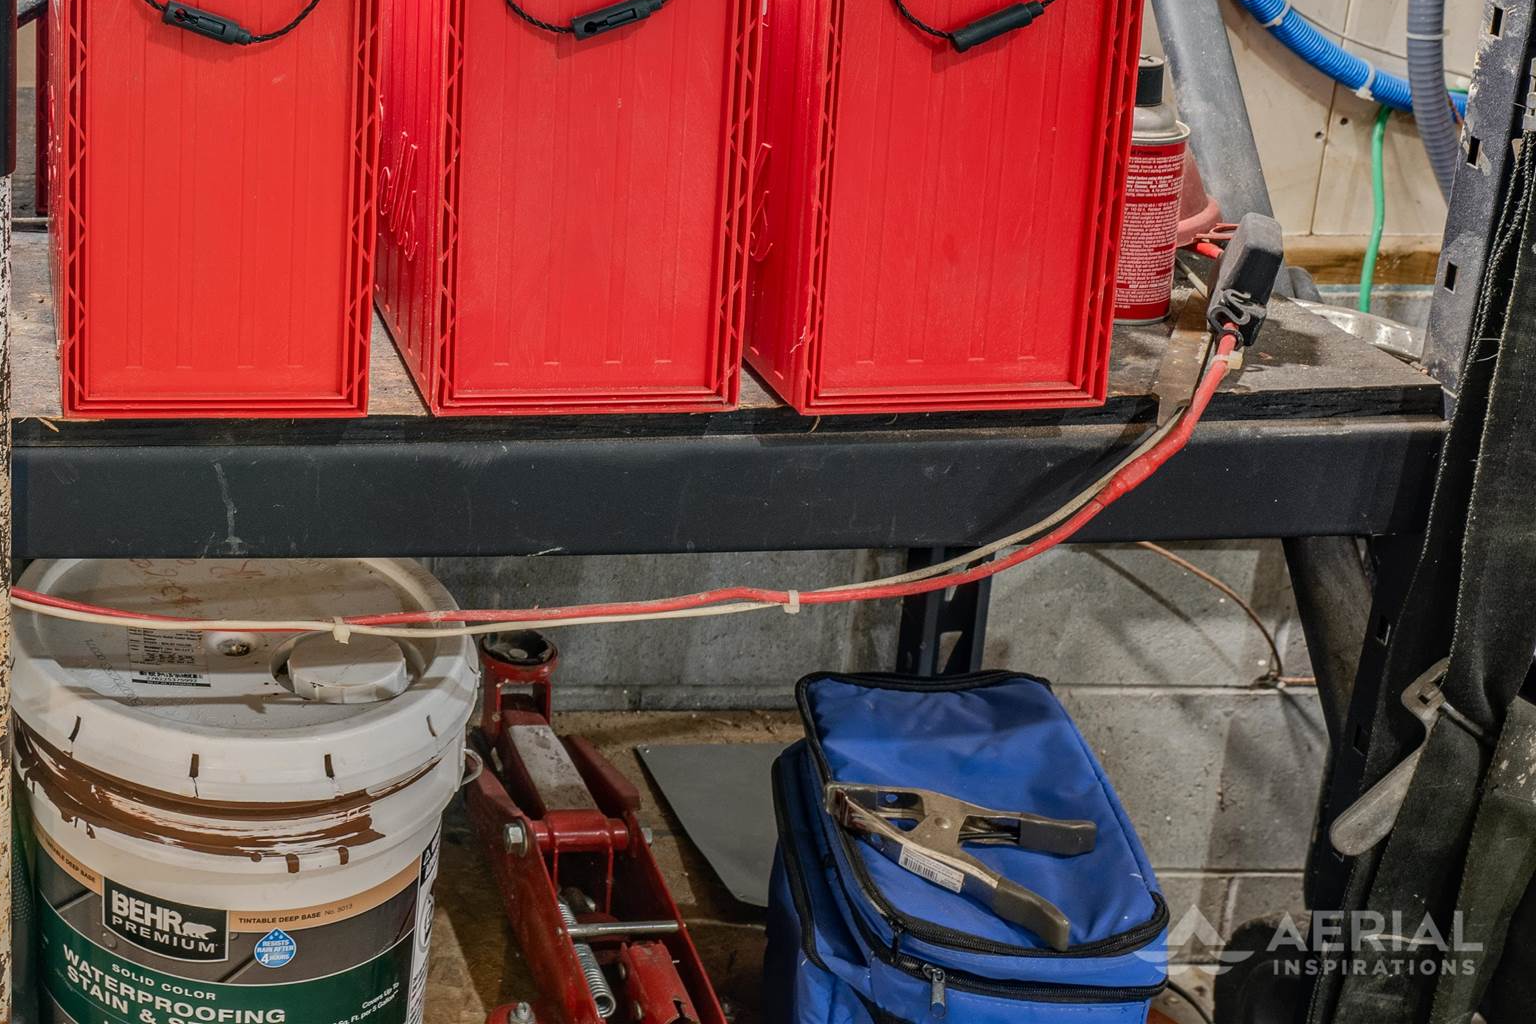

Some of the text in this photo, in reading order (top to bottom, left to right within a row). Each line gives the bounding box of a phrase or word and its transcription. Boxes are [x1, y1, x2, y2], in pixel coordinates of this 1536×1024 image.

[111, 890, 183, 939] BEHR
[239, 916, 277, 924] TINTABLE
[278, 915, 300, 923] DEEP
[301, 912, 321, 920] BASE
[111, 915, 216, 954] PREMIUM
[262, 939, 290, 947] RESISTS
[257, 945, 294, 954] RAIN AFTER
[260, 953, 269, 965] 4
[63, 943, 286, 1024] WATERPROOFING
[66, 964, 129, 1015] STAIN
[111, 963, 217, 1001] SOLID COLOR
[362, 989, 383, 1009] Covers
